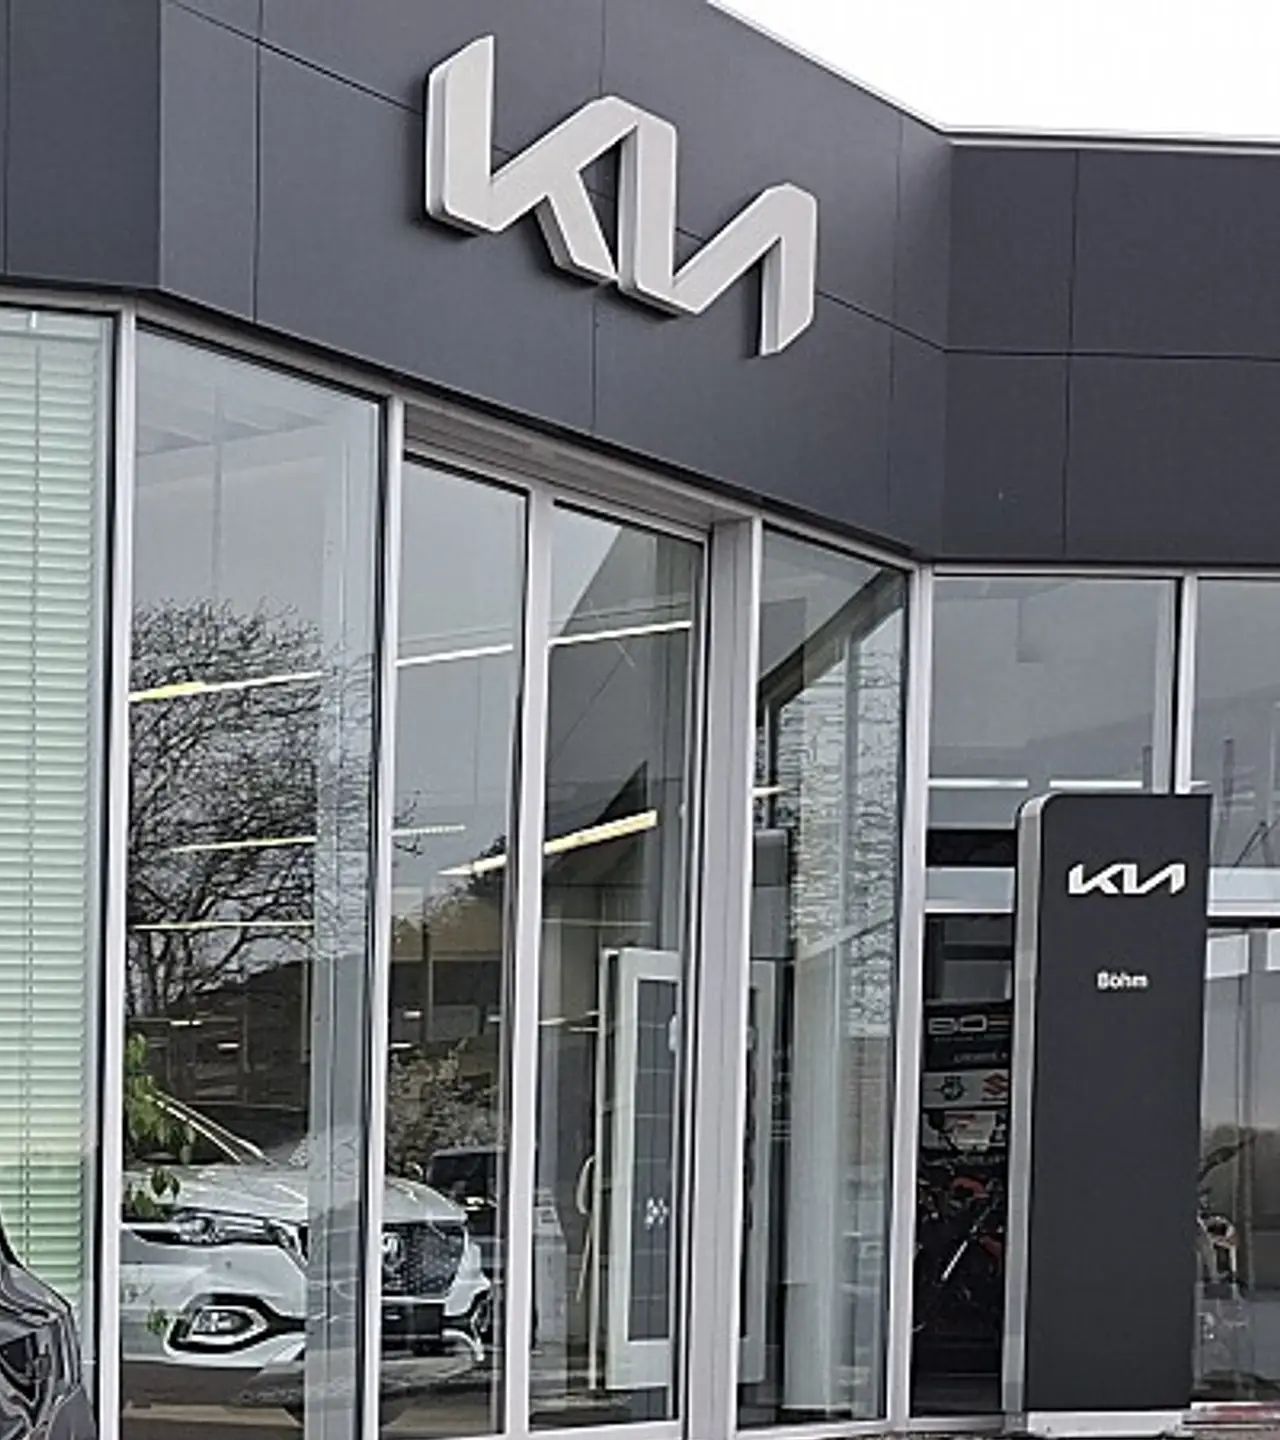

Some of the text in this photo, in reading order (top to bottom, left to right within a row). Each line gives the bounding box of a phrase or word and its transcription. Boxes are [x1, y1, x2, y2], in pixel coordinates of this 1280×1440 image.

[425, 34, 818, 356] KIA
[1068, 863, 1186, 895] KIA
[1096, 970, 1149, 990] Böhm
